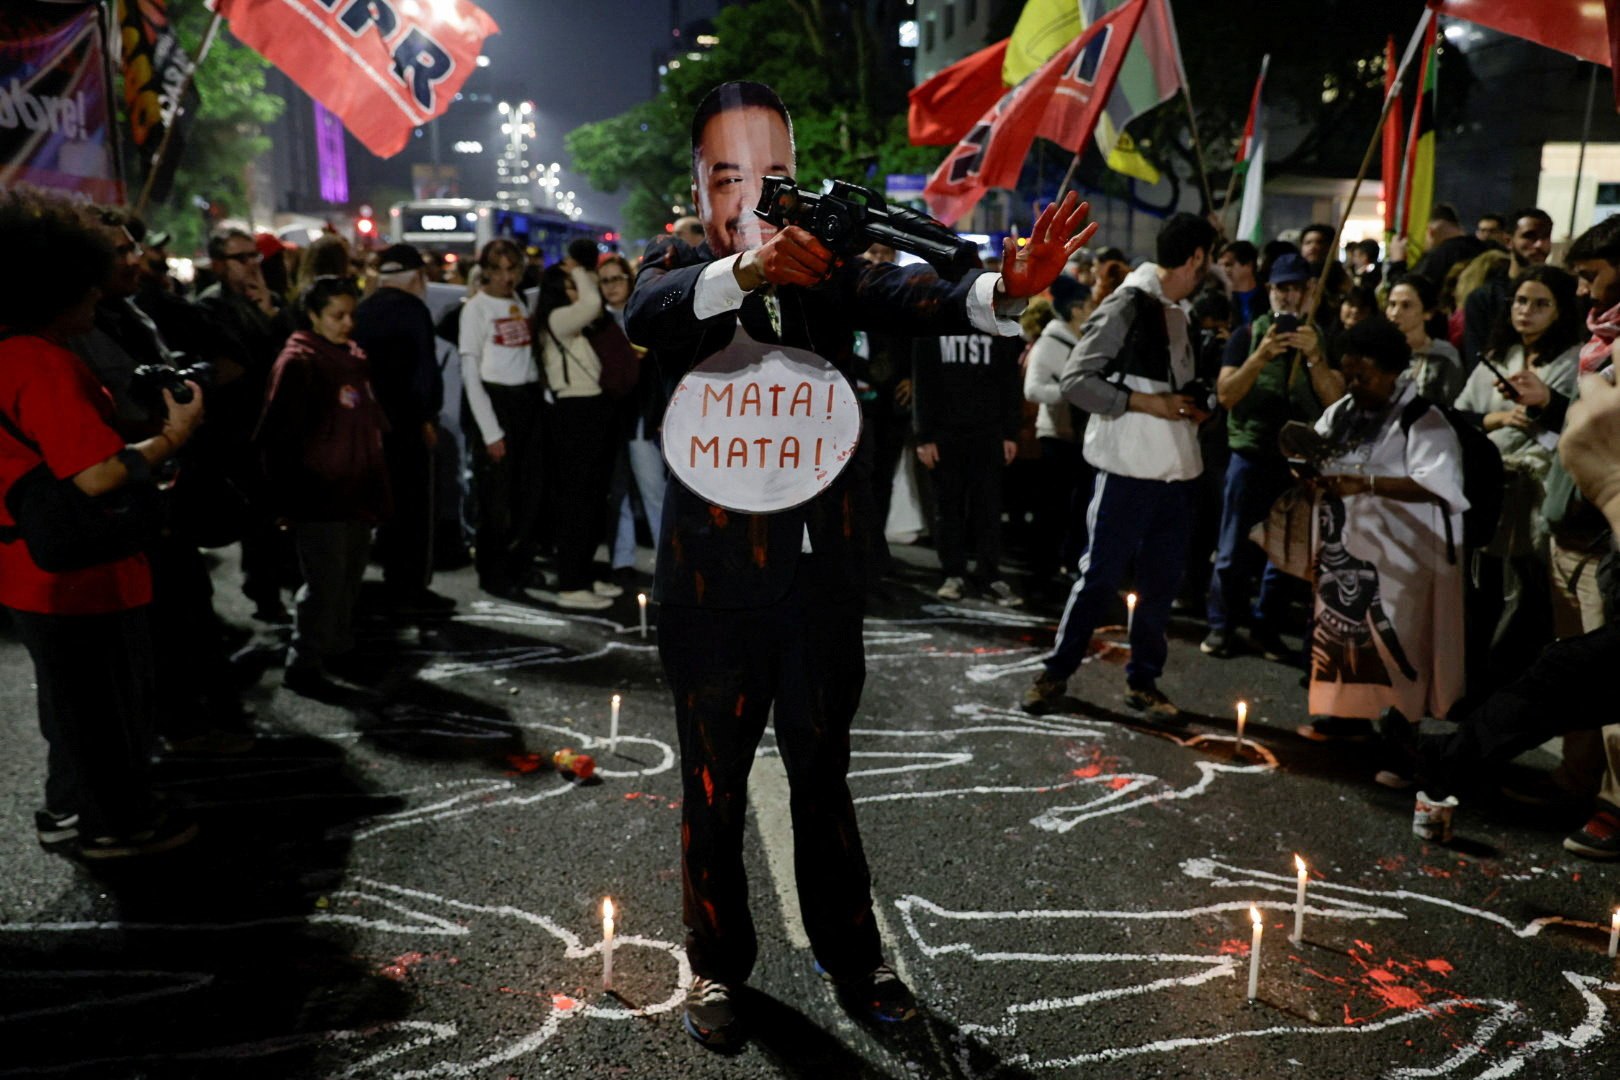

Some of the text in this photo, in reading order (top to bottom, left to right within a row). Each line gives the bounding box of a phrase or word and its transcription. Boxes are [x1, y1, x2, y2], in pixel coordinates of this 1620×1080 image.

[939, 334, 992, 364] MTST
[702, 382, 834, 420] MATA!
[690, 436, 823, 471] MATA!
